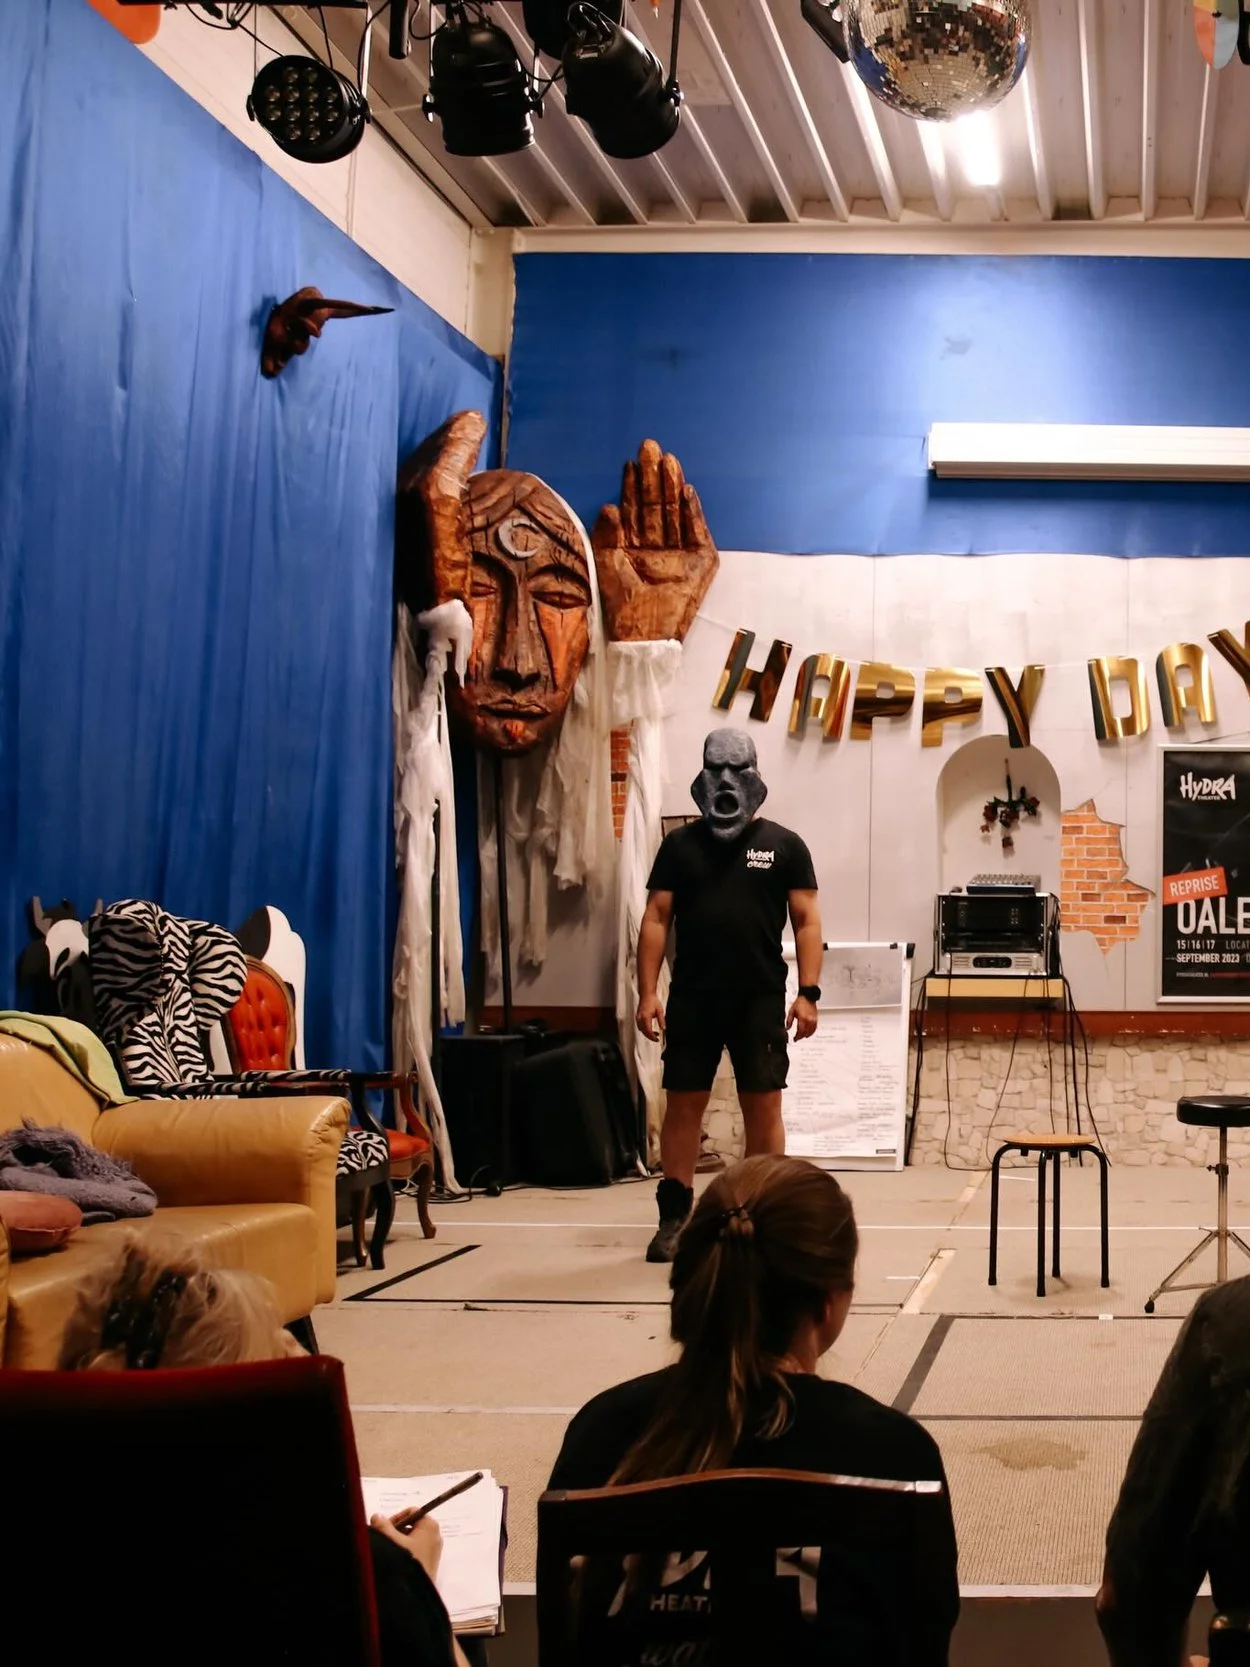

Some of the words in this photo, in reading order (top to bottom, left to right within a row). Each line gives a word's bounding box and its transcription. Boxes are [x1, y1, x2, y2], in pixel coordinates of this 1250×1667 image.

[712, 627, 1046, 748] HAPPY
[1169, 874, 1220, 897] REPRISE
[1176, 953, 1220, 963] SEPTEMBER
[1222, 953, 1240, 963] 2023
[649, 1593, 712, 1614] HEAT
